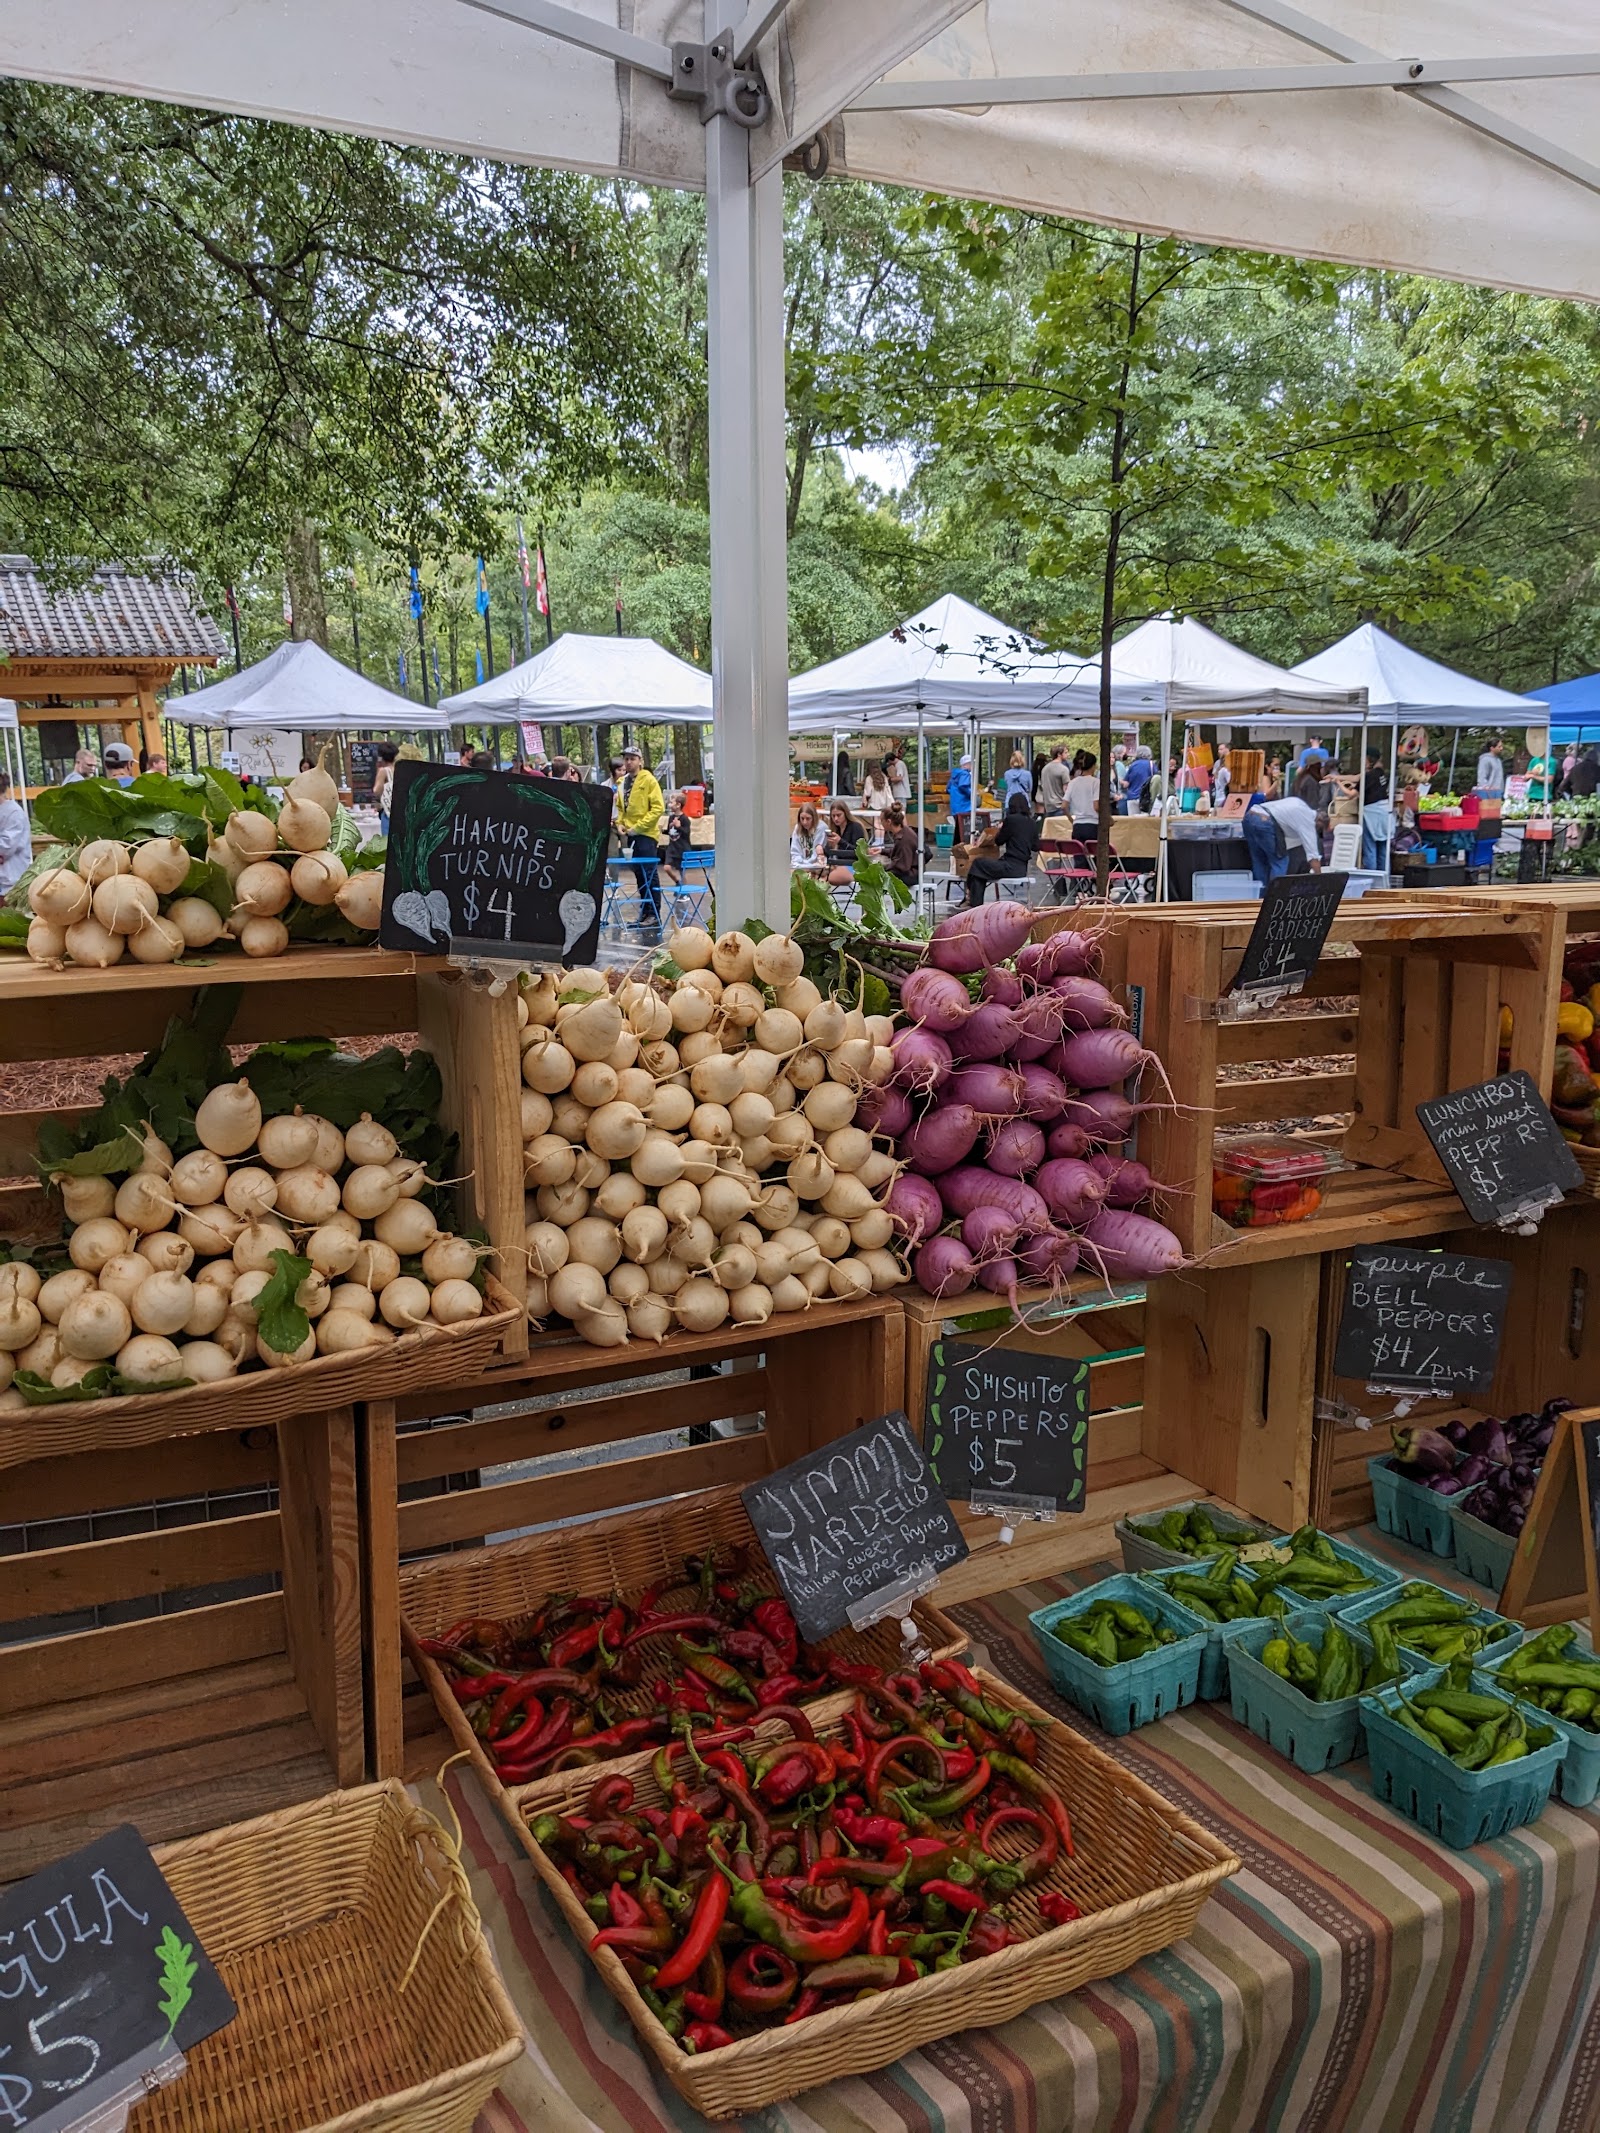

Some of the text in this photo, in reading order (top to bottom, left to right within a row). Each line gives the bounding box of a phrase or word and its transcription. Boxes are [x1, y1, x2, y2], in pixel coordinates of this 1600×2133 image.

[806, 742, 831, 752] Hickory
[453, 813, 562, 861] HAKUREI
[440, 849, 555, 889] TURNIPS
[1271, 893, 1334, 919] DAIKON
[1265, 918, 1322, 940] RADISH
[1485, 1102, 1539, 1131] sweet
[1357, 1257, 1502, 1288] purple
[1352, 1282, 1428, 1307] BELL
[1377, 1308, 1494, 1335] PEPPERS
[965, 1367, 1068, 1403] SHISHITO
[950, 1405, 1069, 1438] PEPPERS
[756, 1420, 925, 1539] JIMMY
[847, 1533, 894, 1570] sweet
